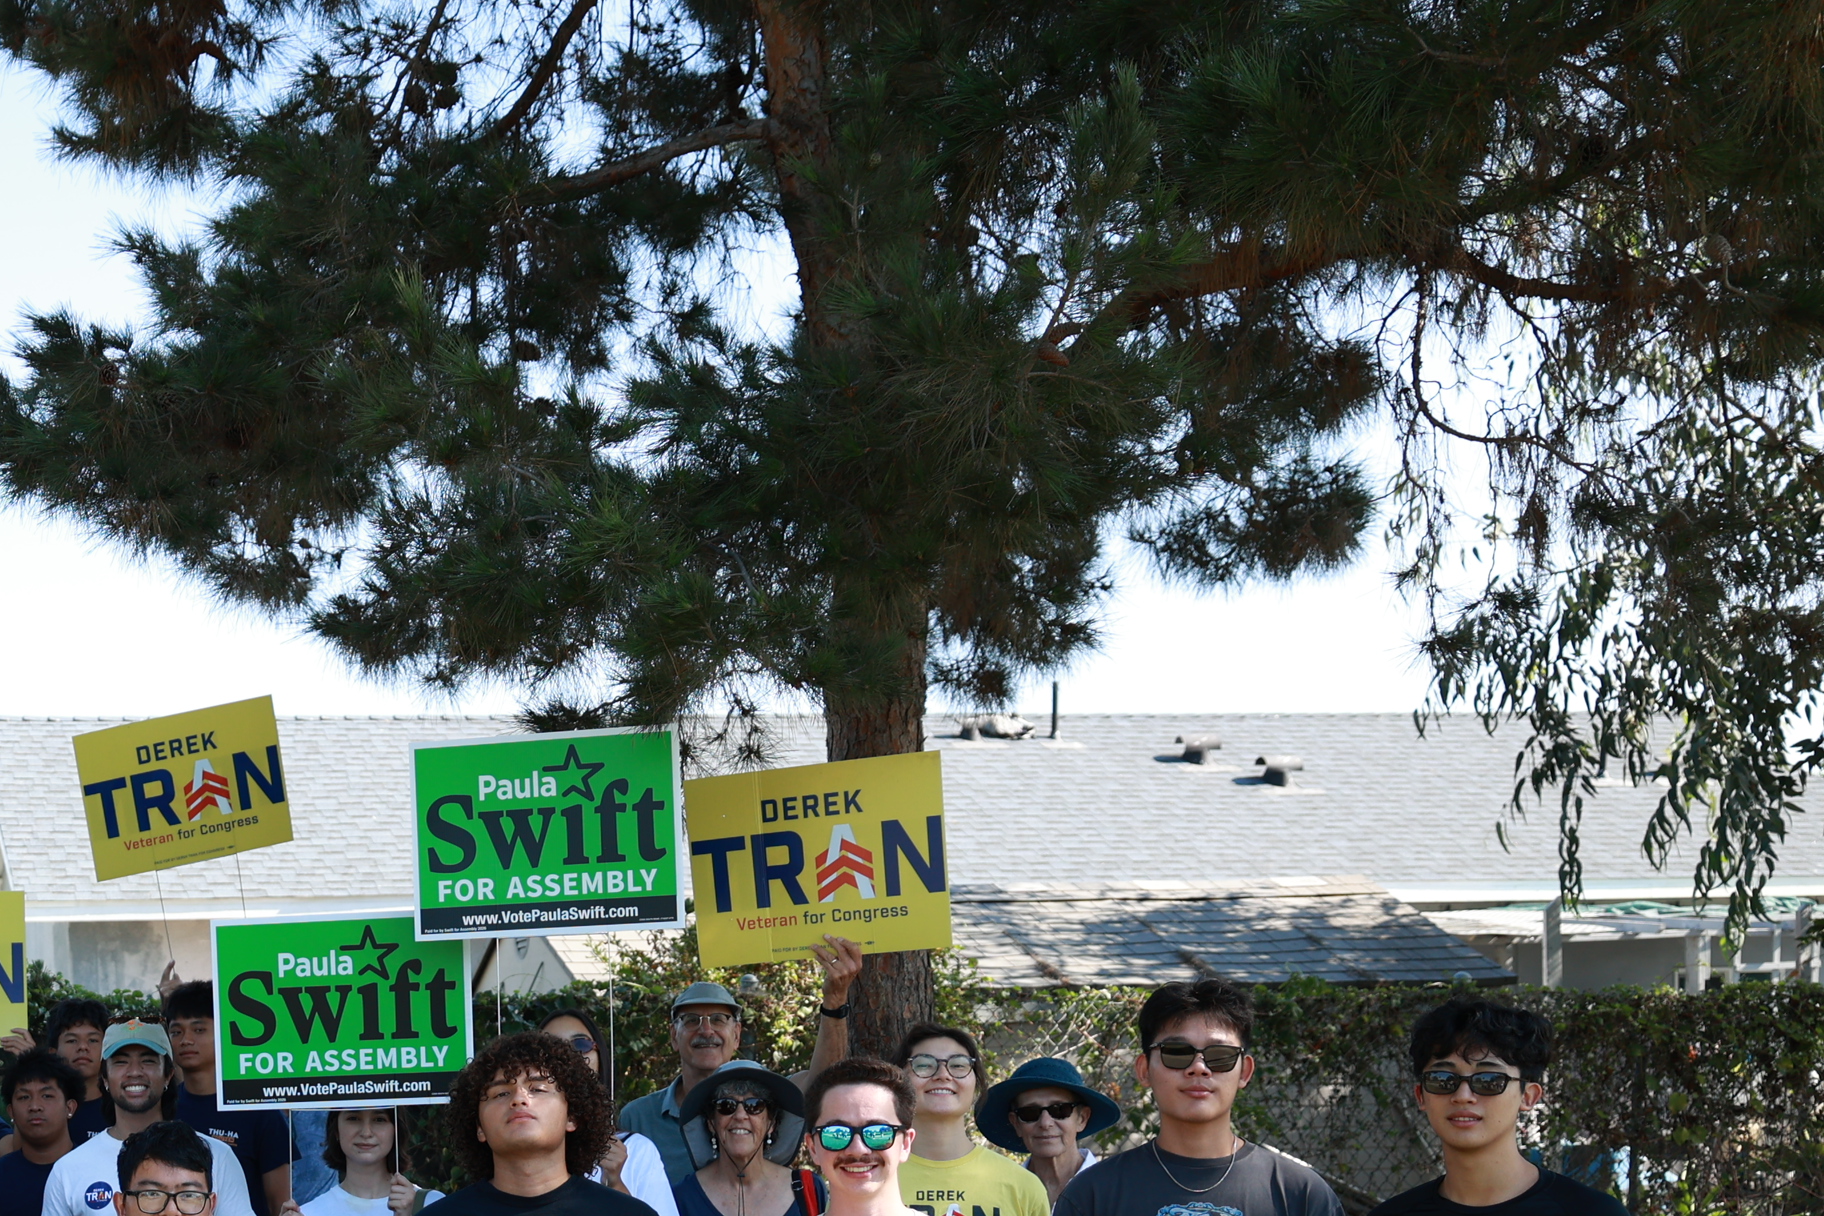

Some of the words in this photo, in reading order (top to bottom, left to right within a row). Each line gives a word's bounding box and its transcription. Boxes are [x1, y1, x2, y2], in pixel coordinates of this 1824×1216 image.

[136, 731, 217, 765] DEREK
[83, 744, 285, 839] TRAN
[478, 770, 557, 801] Paula
[761, 789, 864, 823] DEREK
[124, 833, 174, 851] Veteran
[177, 828, 196, 840] for
[200, 815, 259, 835] Congress
[426, 778, 667, 874] Swift
[691, 815, 946, 913] TRAN
[438, 878, 495, 902] FOR
[506, 868, 658, 898] ASSEMBLY
[462, 905, 639, 926] www.VotePaulaSwift.com
[736, 914, 798, 931] Veteran
[803, 910, 826, 925] for
[832, 905, 909, 923] Congress
[277, 950, 353, 978] Paula
[227, 958, 458, 1046] Swift
[239, 1052, 294, 1074] FOR
[305, 1045, 449, 1072] ASSEMBLY
[262, 1080, 431, 1097] www.VotePaulaSwift.com
[208, 1128, 239, 1139] THU-HA
[86, 1190, 112, 1201] TRAN
[916, 1190, 965, 1201] DEREK
